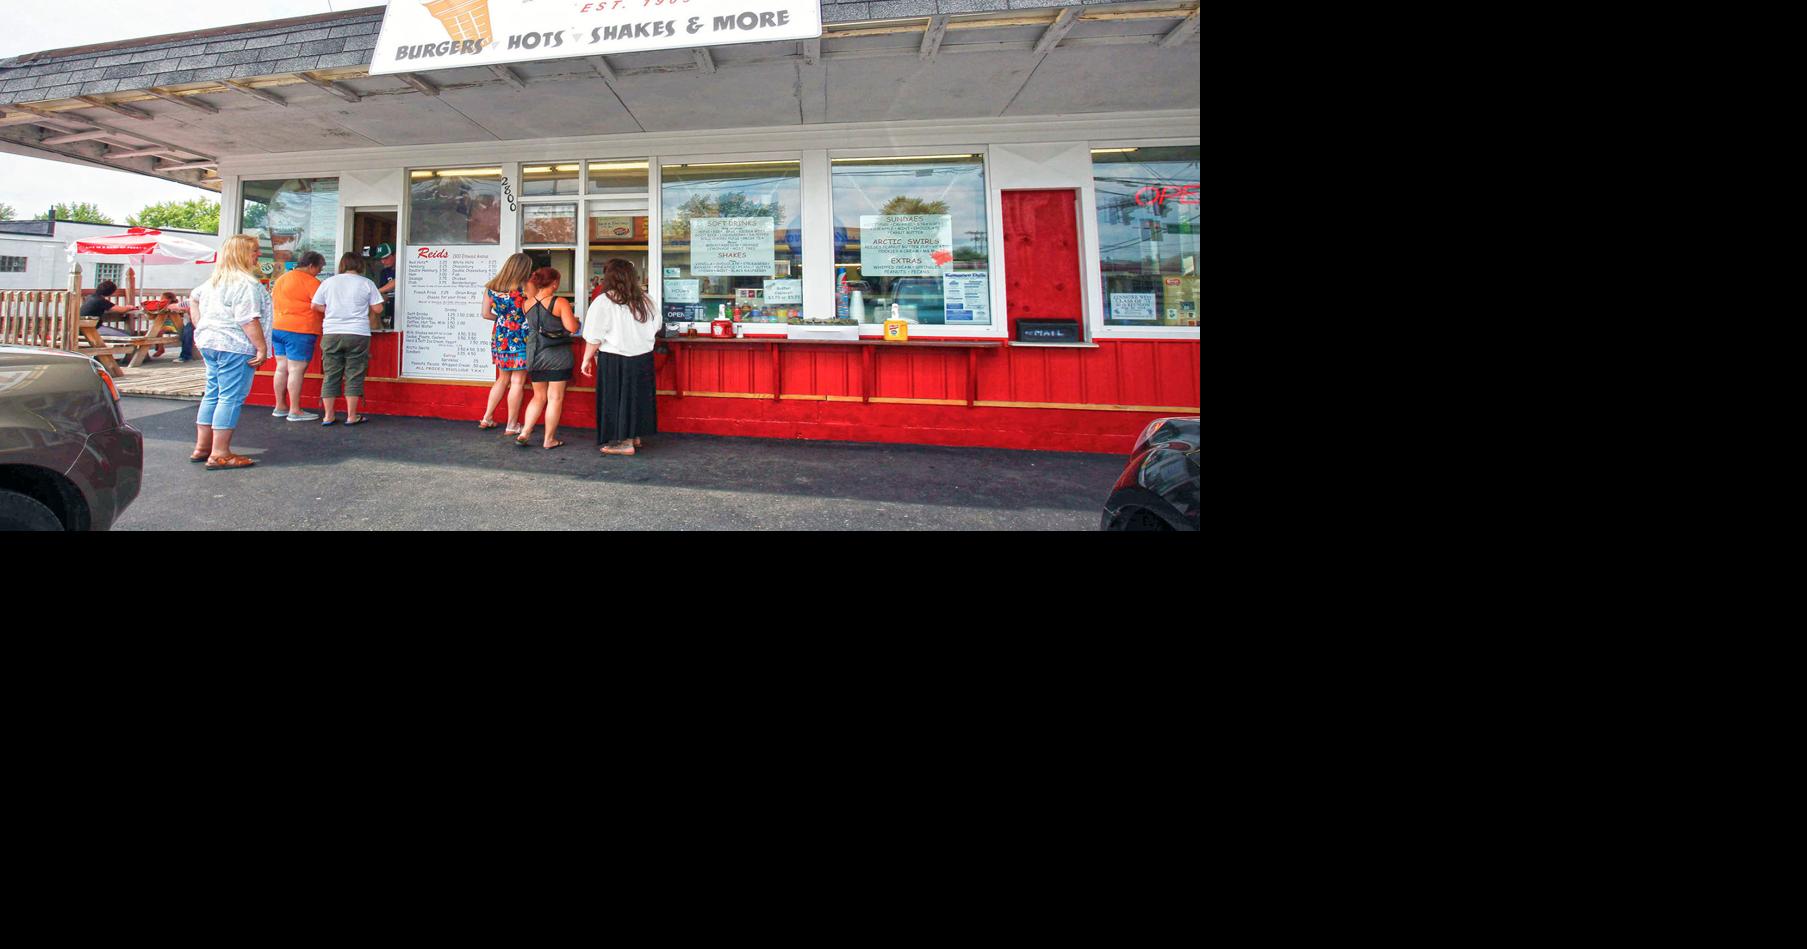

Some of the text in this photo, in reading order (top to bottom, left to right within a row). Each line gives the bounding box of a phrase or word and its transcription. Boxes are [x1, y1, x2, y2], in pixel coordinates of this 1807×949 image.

[580, 1, 626, 13] EST.
[395, 9, 790, 61] BURGERS HOTS SHAKES & MORE
[501, 177, 516, 211] 2800
[418, 247, 448, 259] Reids
